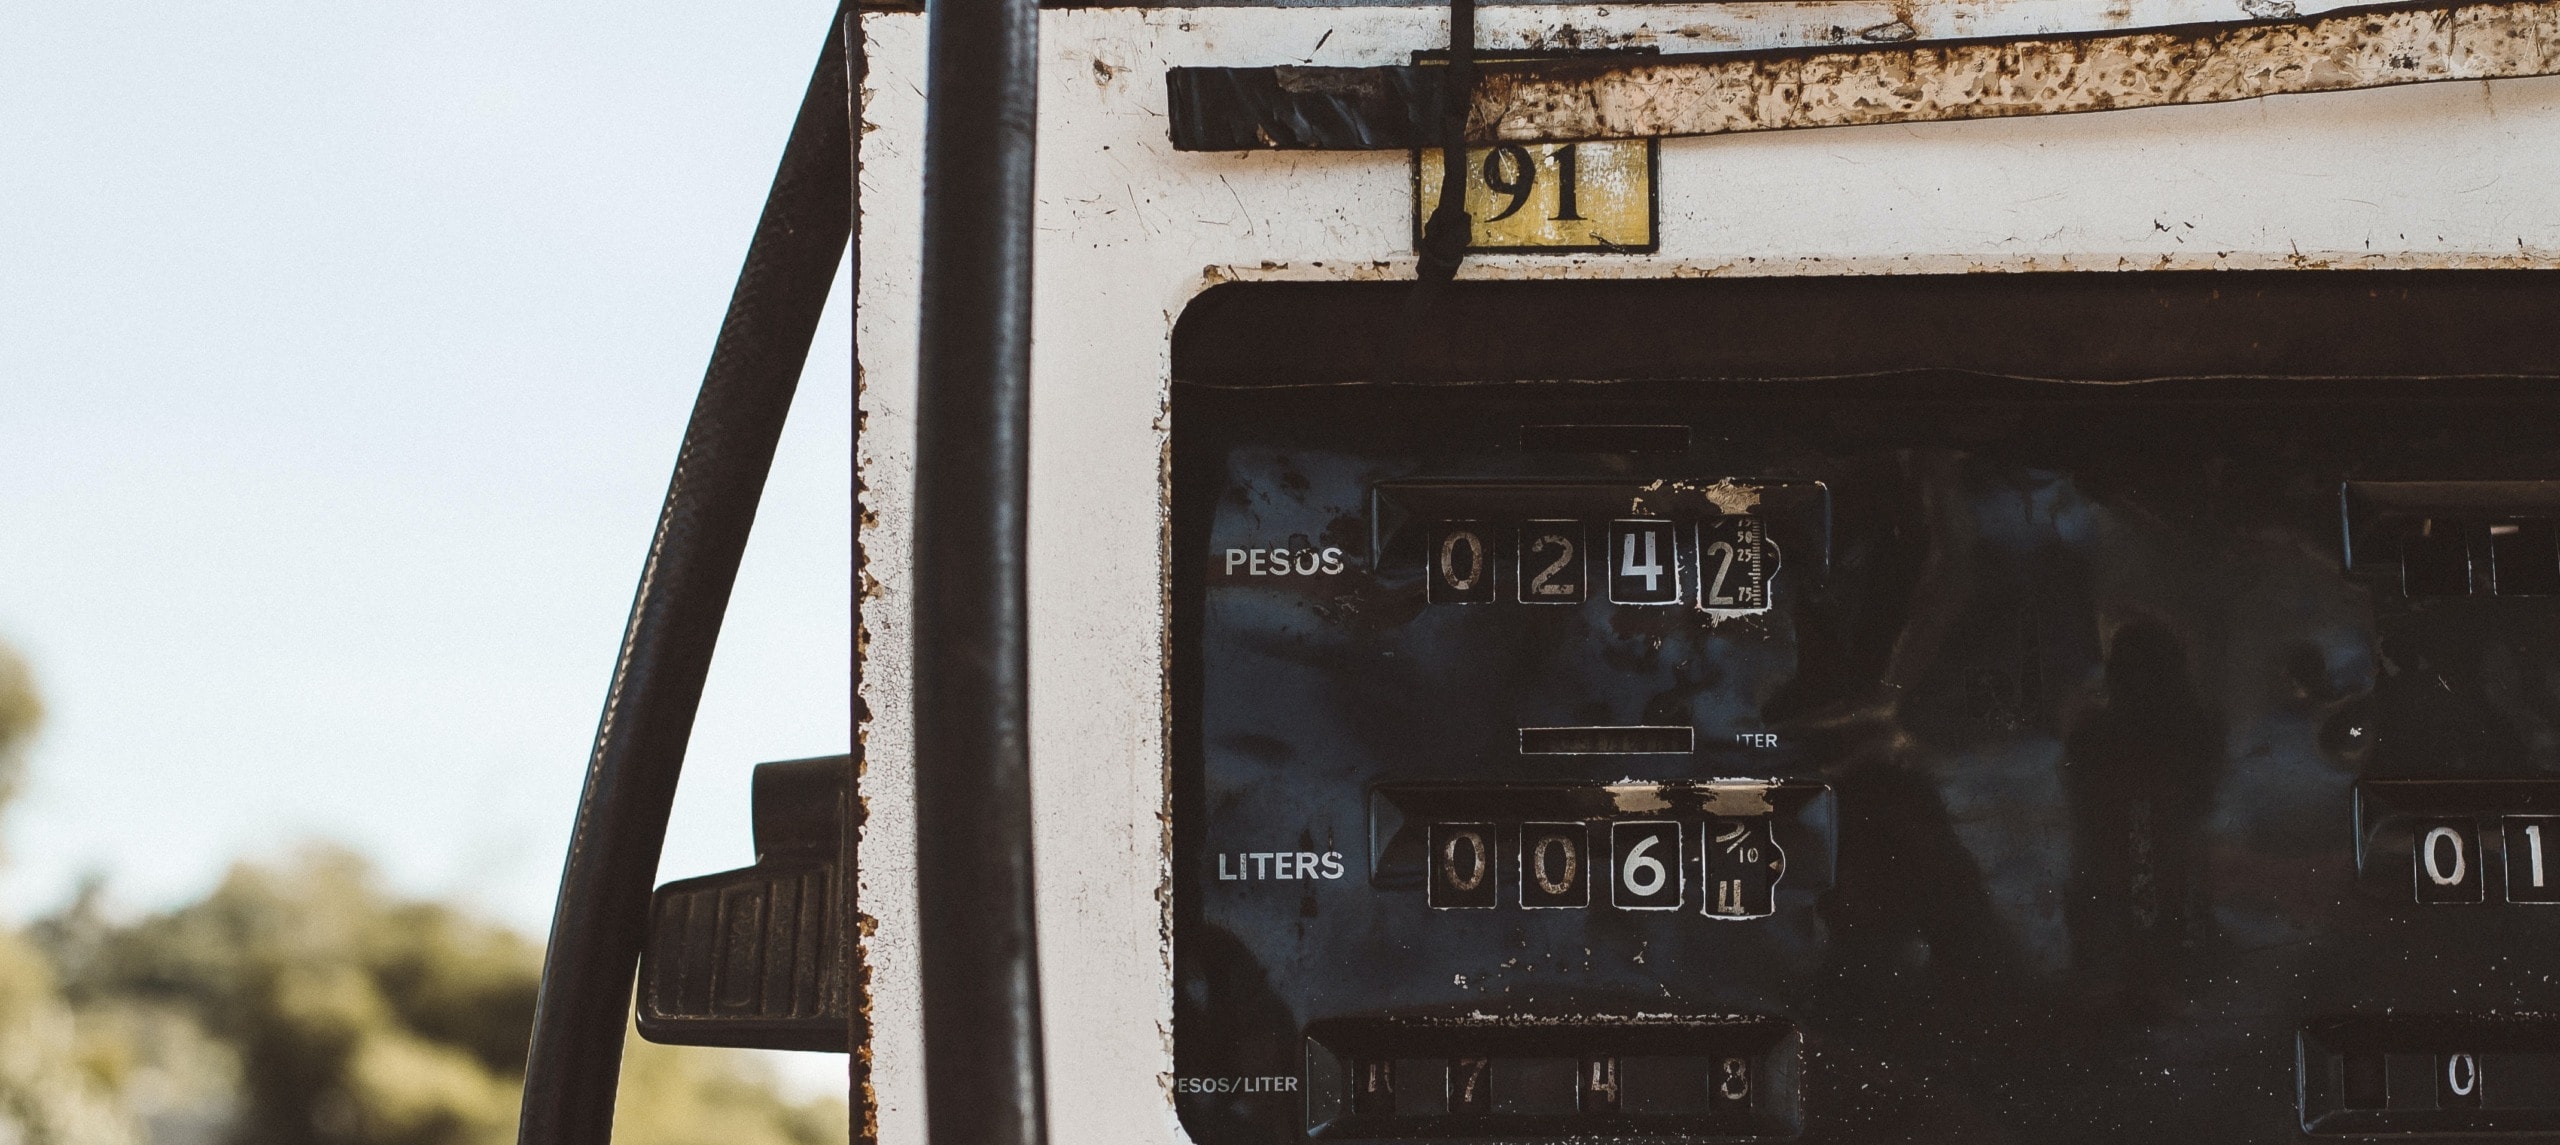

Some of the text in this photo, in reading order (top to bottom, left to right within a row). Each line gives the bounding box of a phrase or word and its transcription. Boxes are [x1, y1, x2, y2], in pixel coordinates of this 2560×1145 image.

[1484, 143, 1587, 223] 91
[1225, 547, 1343, 576] PESOS
[1219, 852, 1345, 881] LITERS
